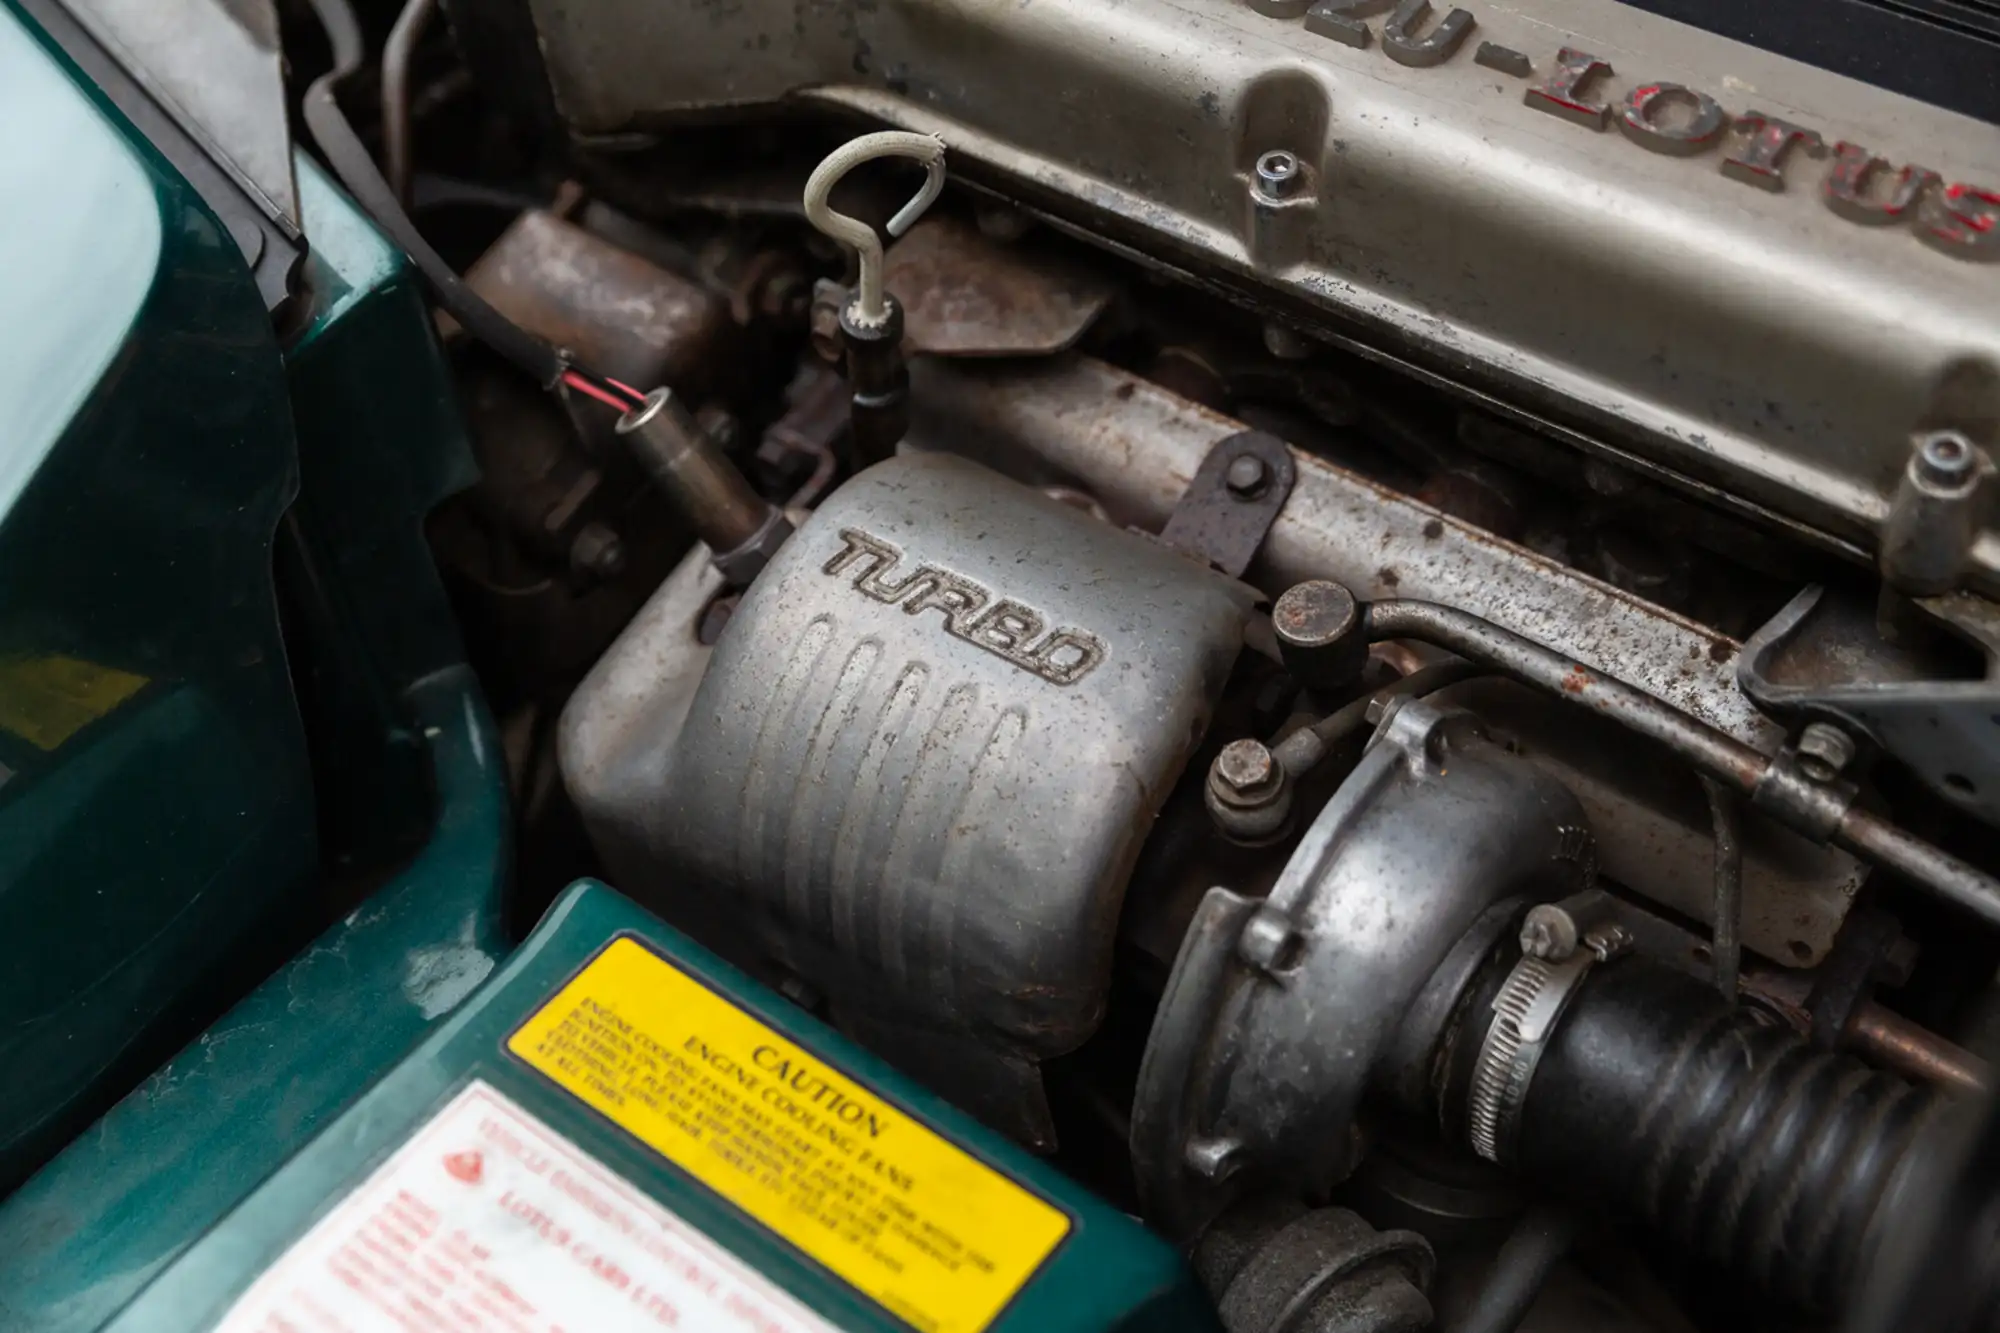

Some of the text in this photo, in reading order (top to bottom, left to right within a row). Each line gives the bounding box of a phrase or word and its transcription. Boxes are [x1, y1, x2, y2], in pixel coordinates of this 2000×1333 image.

[822, 526, 1110, 687] TURBO
[578, 996, 635, 1035] ENGINE
[630, 1030, 703, 1080] COOLING
[746, 1041, 892, 1141] CAUTION
[679, 1034, 919, 1195] ENGINE COOLING FANS
